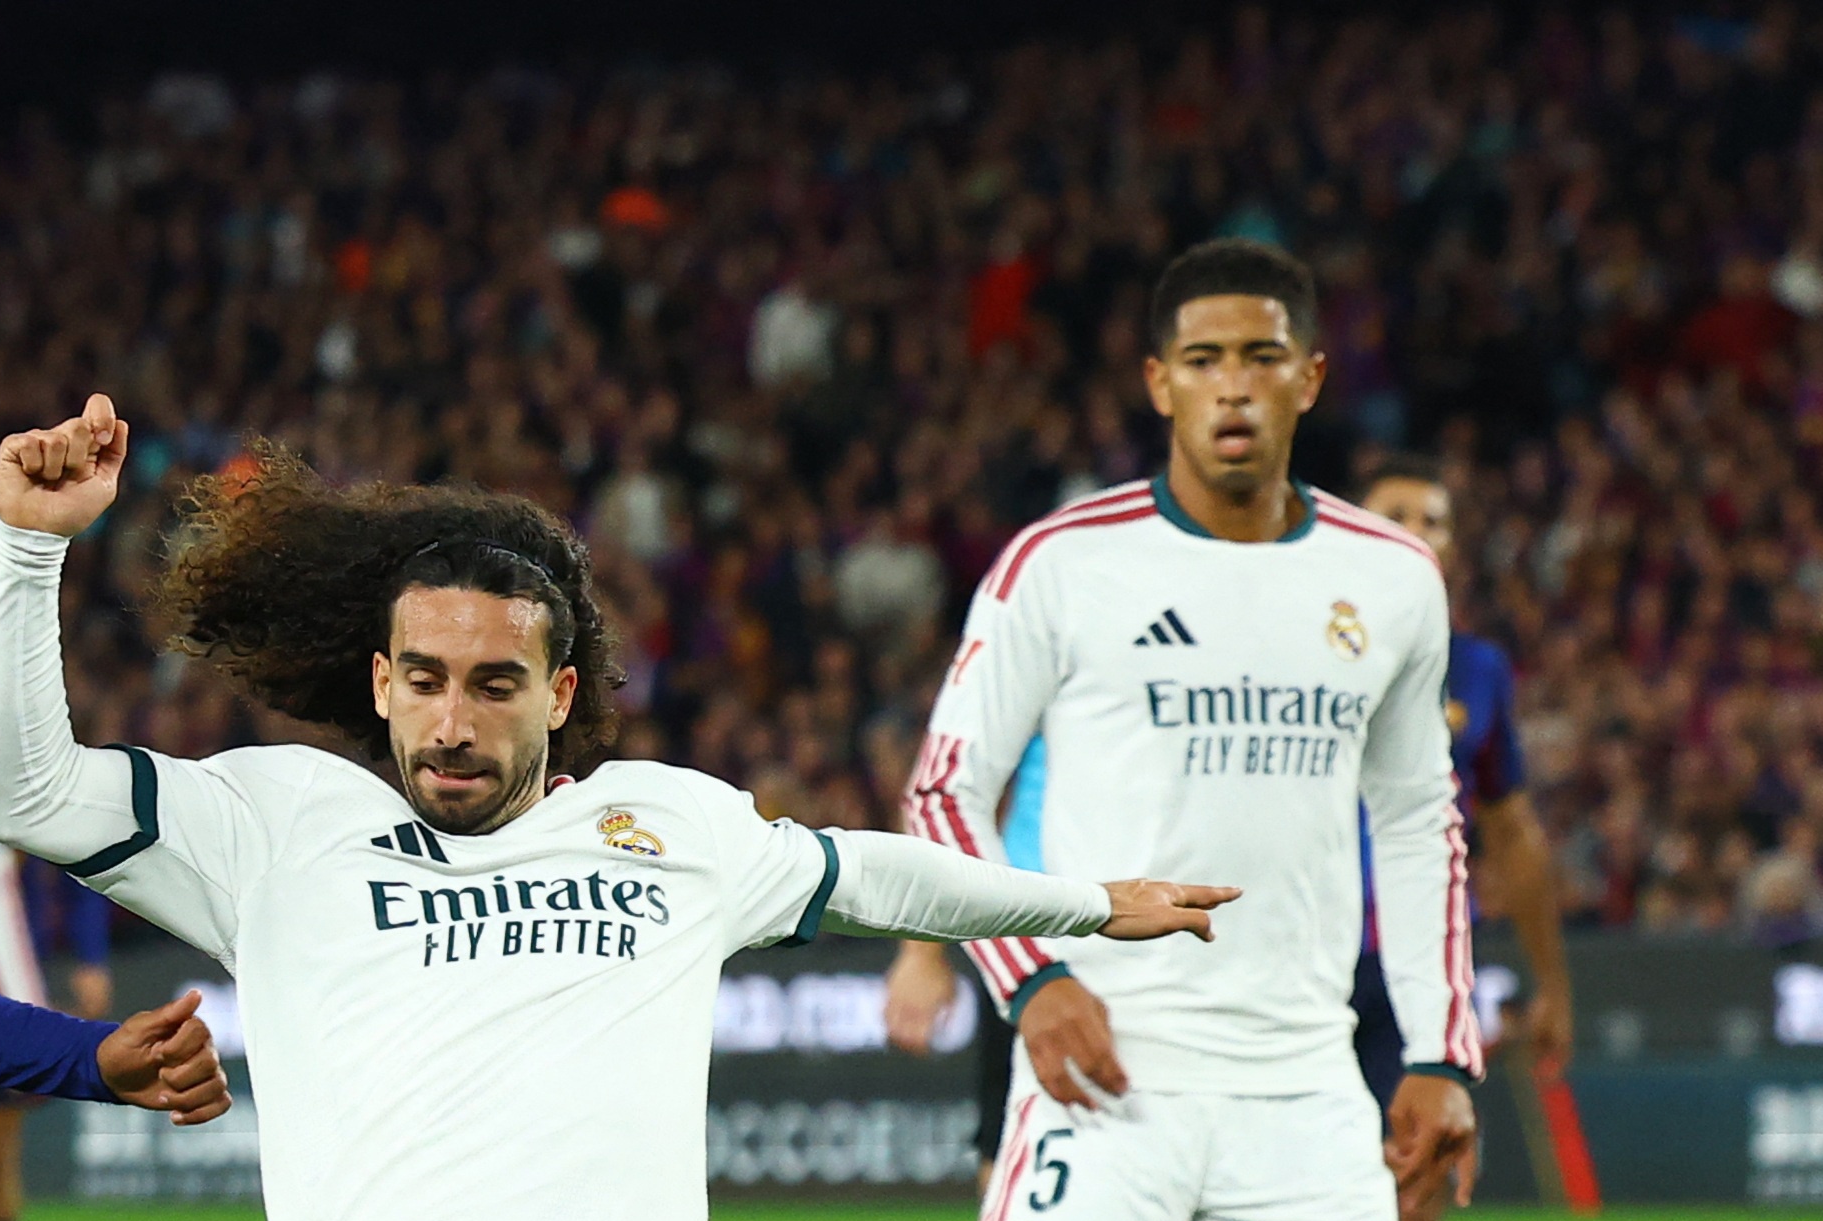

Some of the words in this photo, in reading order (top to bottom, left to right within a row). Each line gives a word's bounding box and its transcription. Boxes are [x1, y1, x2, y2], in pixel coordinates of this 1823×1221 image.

[1184, 735, 1234, 776] FLY
[1245, 735, 1340, 777] BETTER
[366, 869, 671, 931] Emirates
[423, 921, 486, 968] FLY
[502, 919, 638, 961] BETTER
[1029, 1128, 1075, 1213] 5
